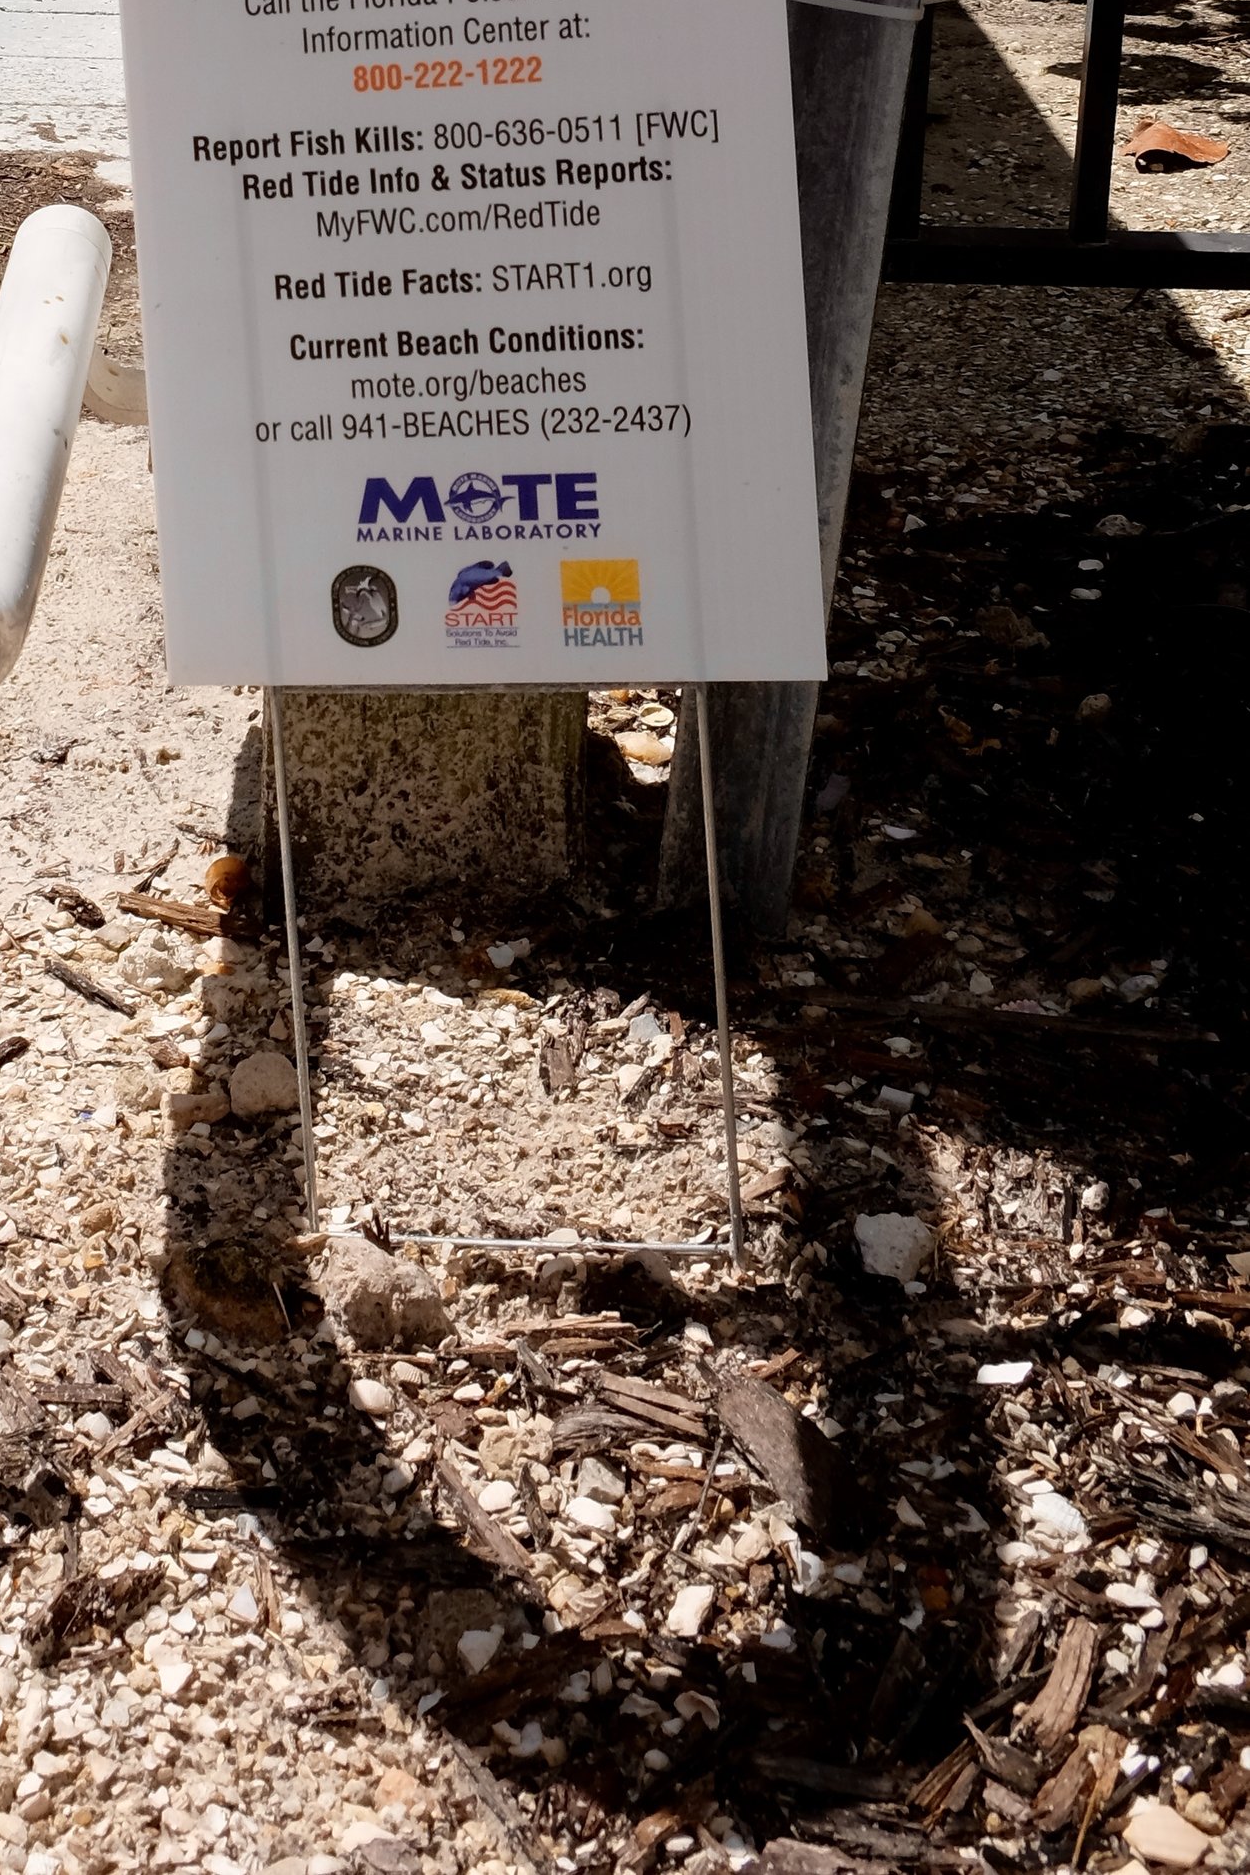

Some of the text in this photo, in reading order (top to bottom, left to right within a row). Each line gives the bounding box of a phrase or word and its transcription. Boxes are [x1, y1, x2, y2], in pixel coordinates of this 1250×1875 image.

[303, 13, 589, 53] Information Center at:
[354, 56, 542, 92] 800-222-1222
[193, 109, 718, 166] Report Fish Kills: 800-636-0511 [FWC]
[243, 156, 671, 200] Red Tide Info & Status Reports:
[317, 200, 600, 242] MyFWC.com/RedTide
[275, 262, 651, 300] Red Tide Facts: START1.org
[290, 324, 643, 360] Current Beach Conditions:
[352, 367, 586, 401] mote.org/beaches
[256, 404, 691, 442] or call 941-BEACHES (232-2437)
[357, 523, 601, 542] MARINE LABORATORY
[445, 612, 518, 627] START
[485, 628, 494, 637] To
[562, 604, 641, 627] Florida
[564, 627, 644, 647] HEALTH
